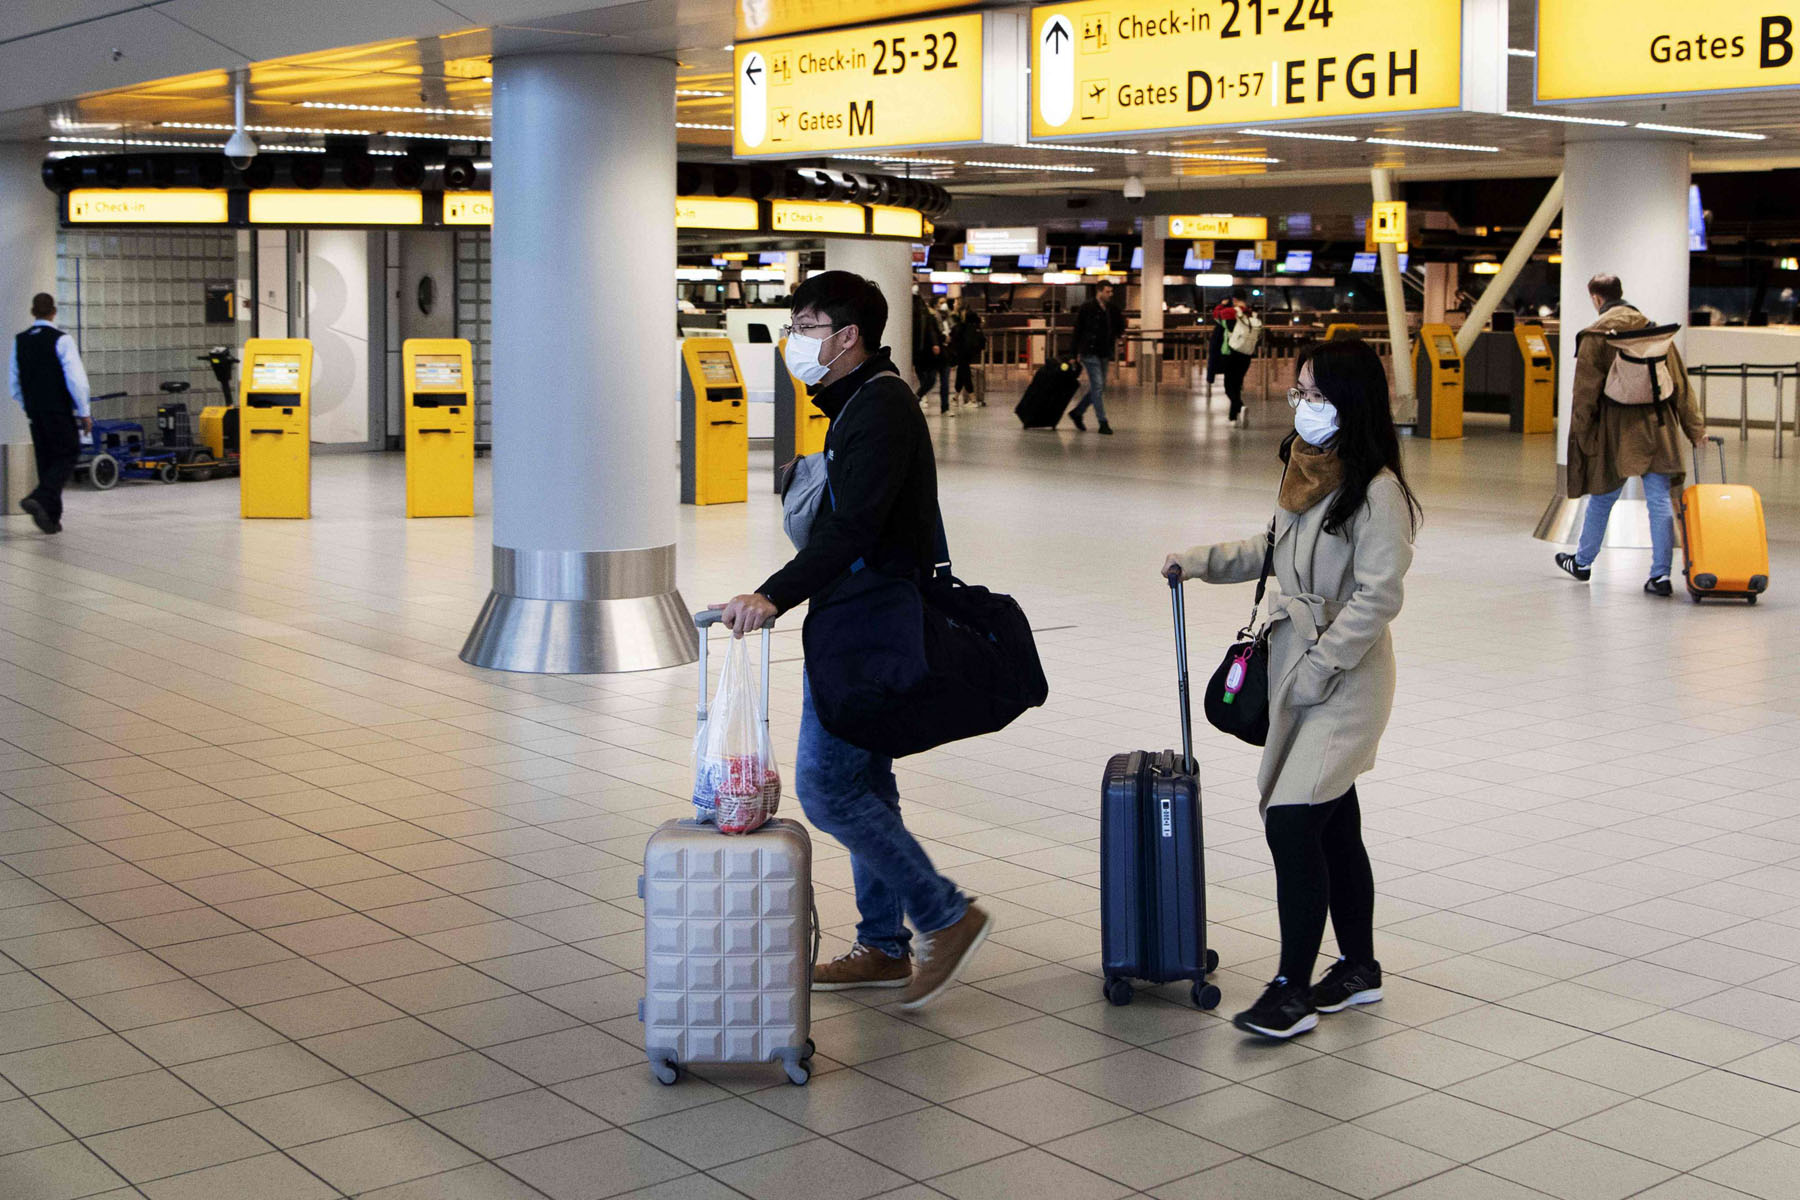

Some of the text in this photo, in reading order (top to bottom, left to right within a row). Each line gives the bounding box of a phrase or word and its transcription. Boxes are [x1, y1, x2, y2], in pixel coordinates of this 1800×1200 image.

[1118, 0, 1333, 40] Check-in 21-24
[799, 31, 958, 75] Check-in 25-32
[1650, 15, 1794, 69] Gates B
[1118, 83, 1178, 107] Gates
[798, 100, 874, 136] Gates M
[95, 200, 145, 213] Check-in
[1196, 221, 1229, 234] Gates M
